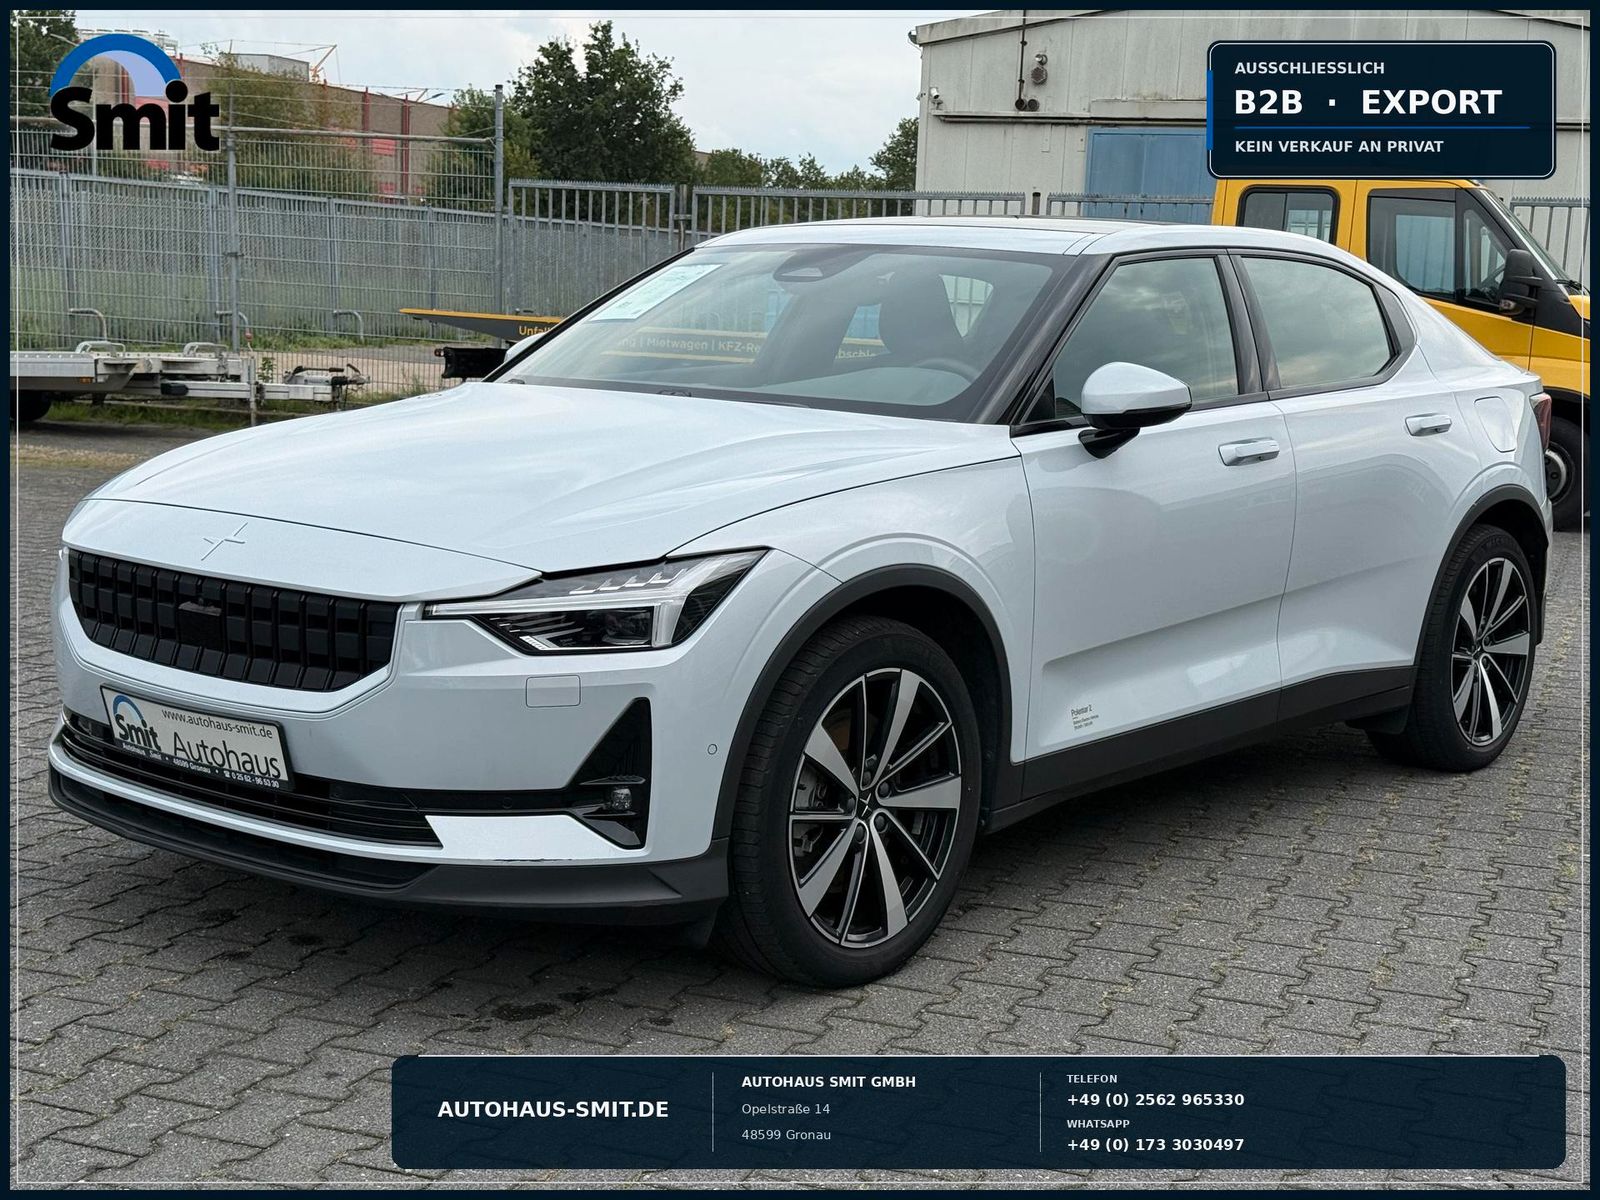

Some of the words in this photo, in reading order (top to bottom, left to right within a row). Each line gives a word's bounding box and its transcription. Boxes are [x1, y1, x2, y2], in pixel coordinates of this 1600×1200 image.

[646, 337, 708, 351] Mietwagen
[114, 713, 162, 752] Smit
[160, 708, 273, 739] www.autohaus-smit.de
[172, 731, 281, 779] Autohaus
